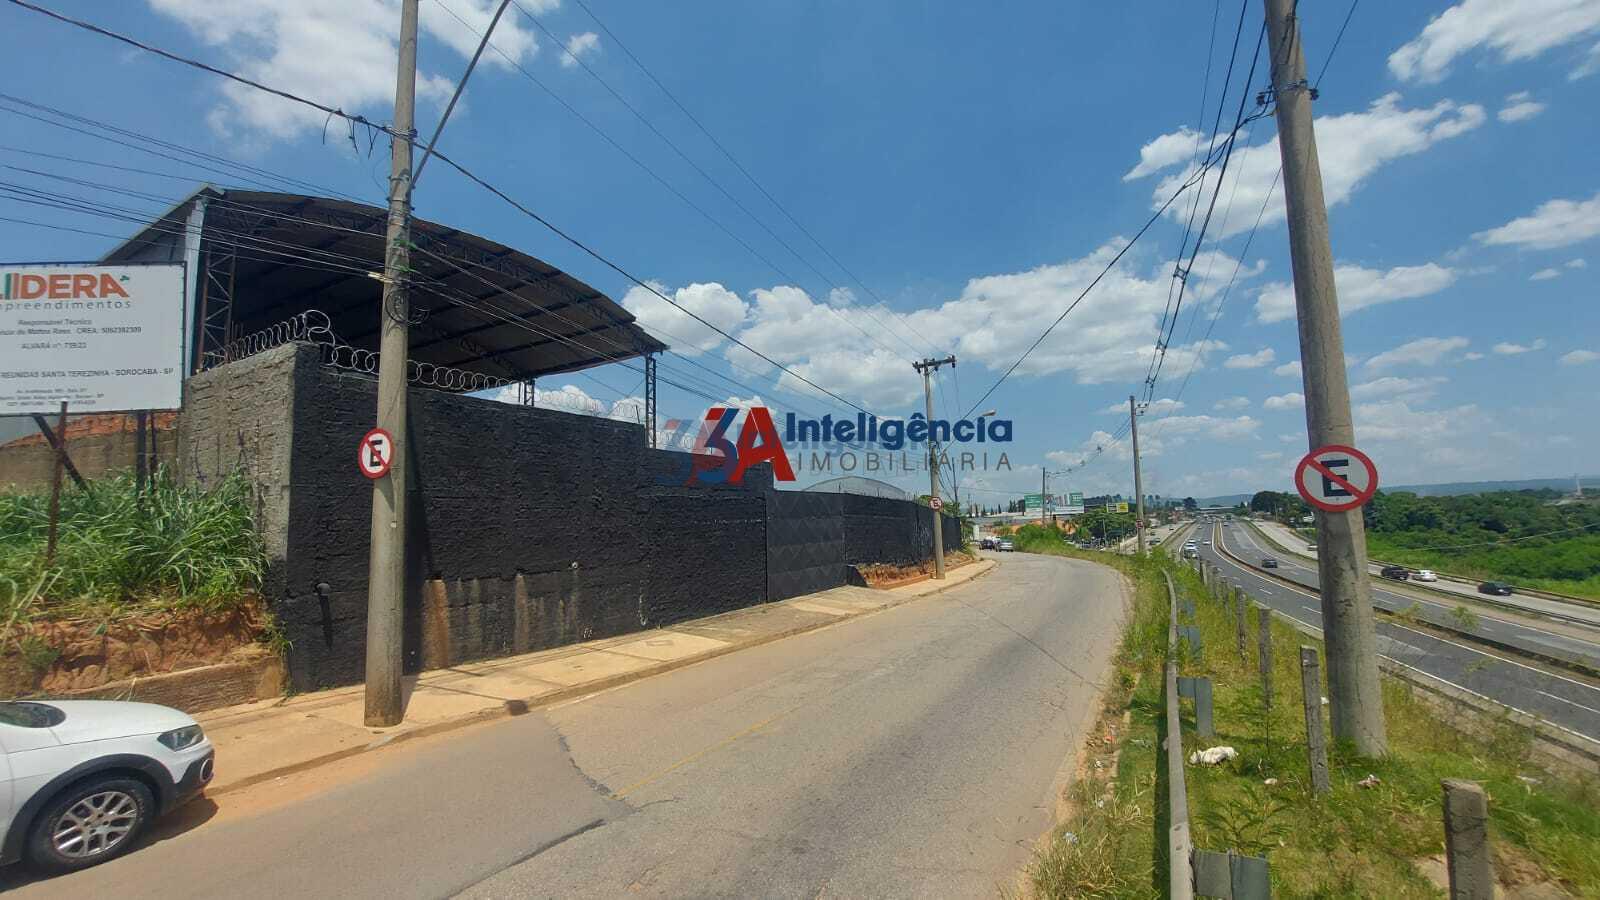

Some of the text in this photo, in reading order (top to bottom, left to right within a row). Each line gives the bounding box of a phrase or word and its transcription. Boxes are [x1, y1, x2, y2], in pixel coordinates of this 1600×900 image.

[115, 368, 157, 376] SOROCABA
[369, 440, 383, 467] E
[1321, 459, 1353, 497] E
